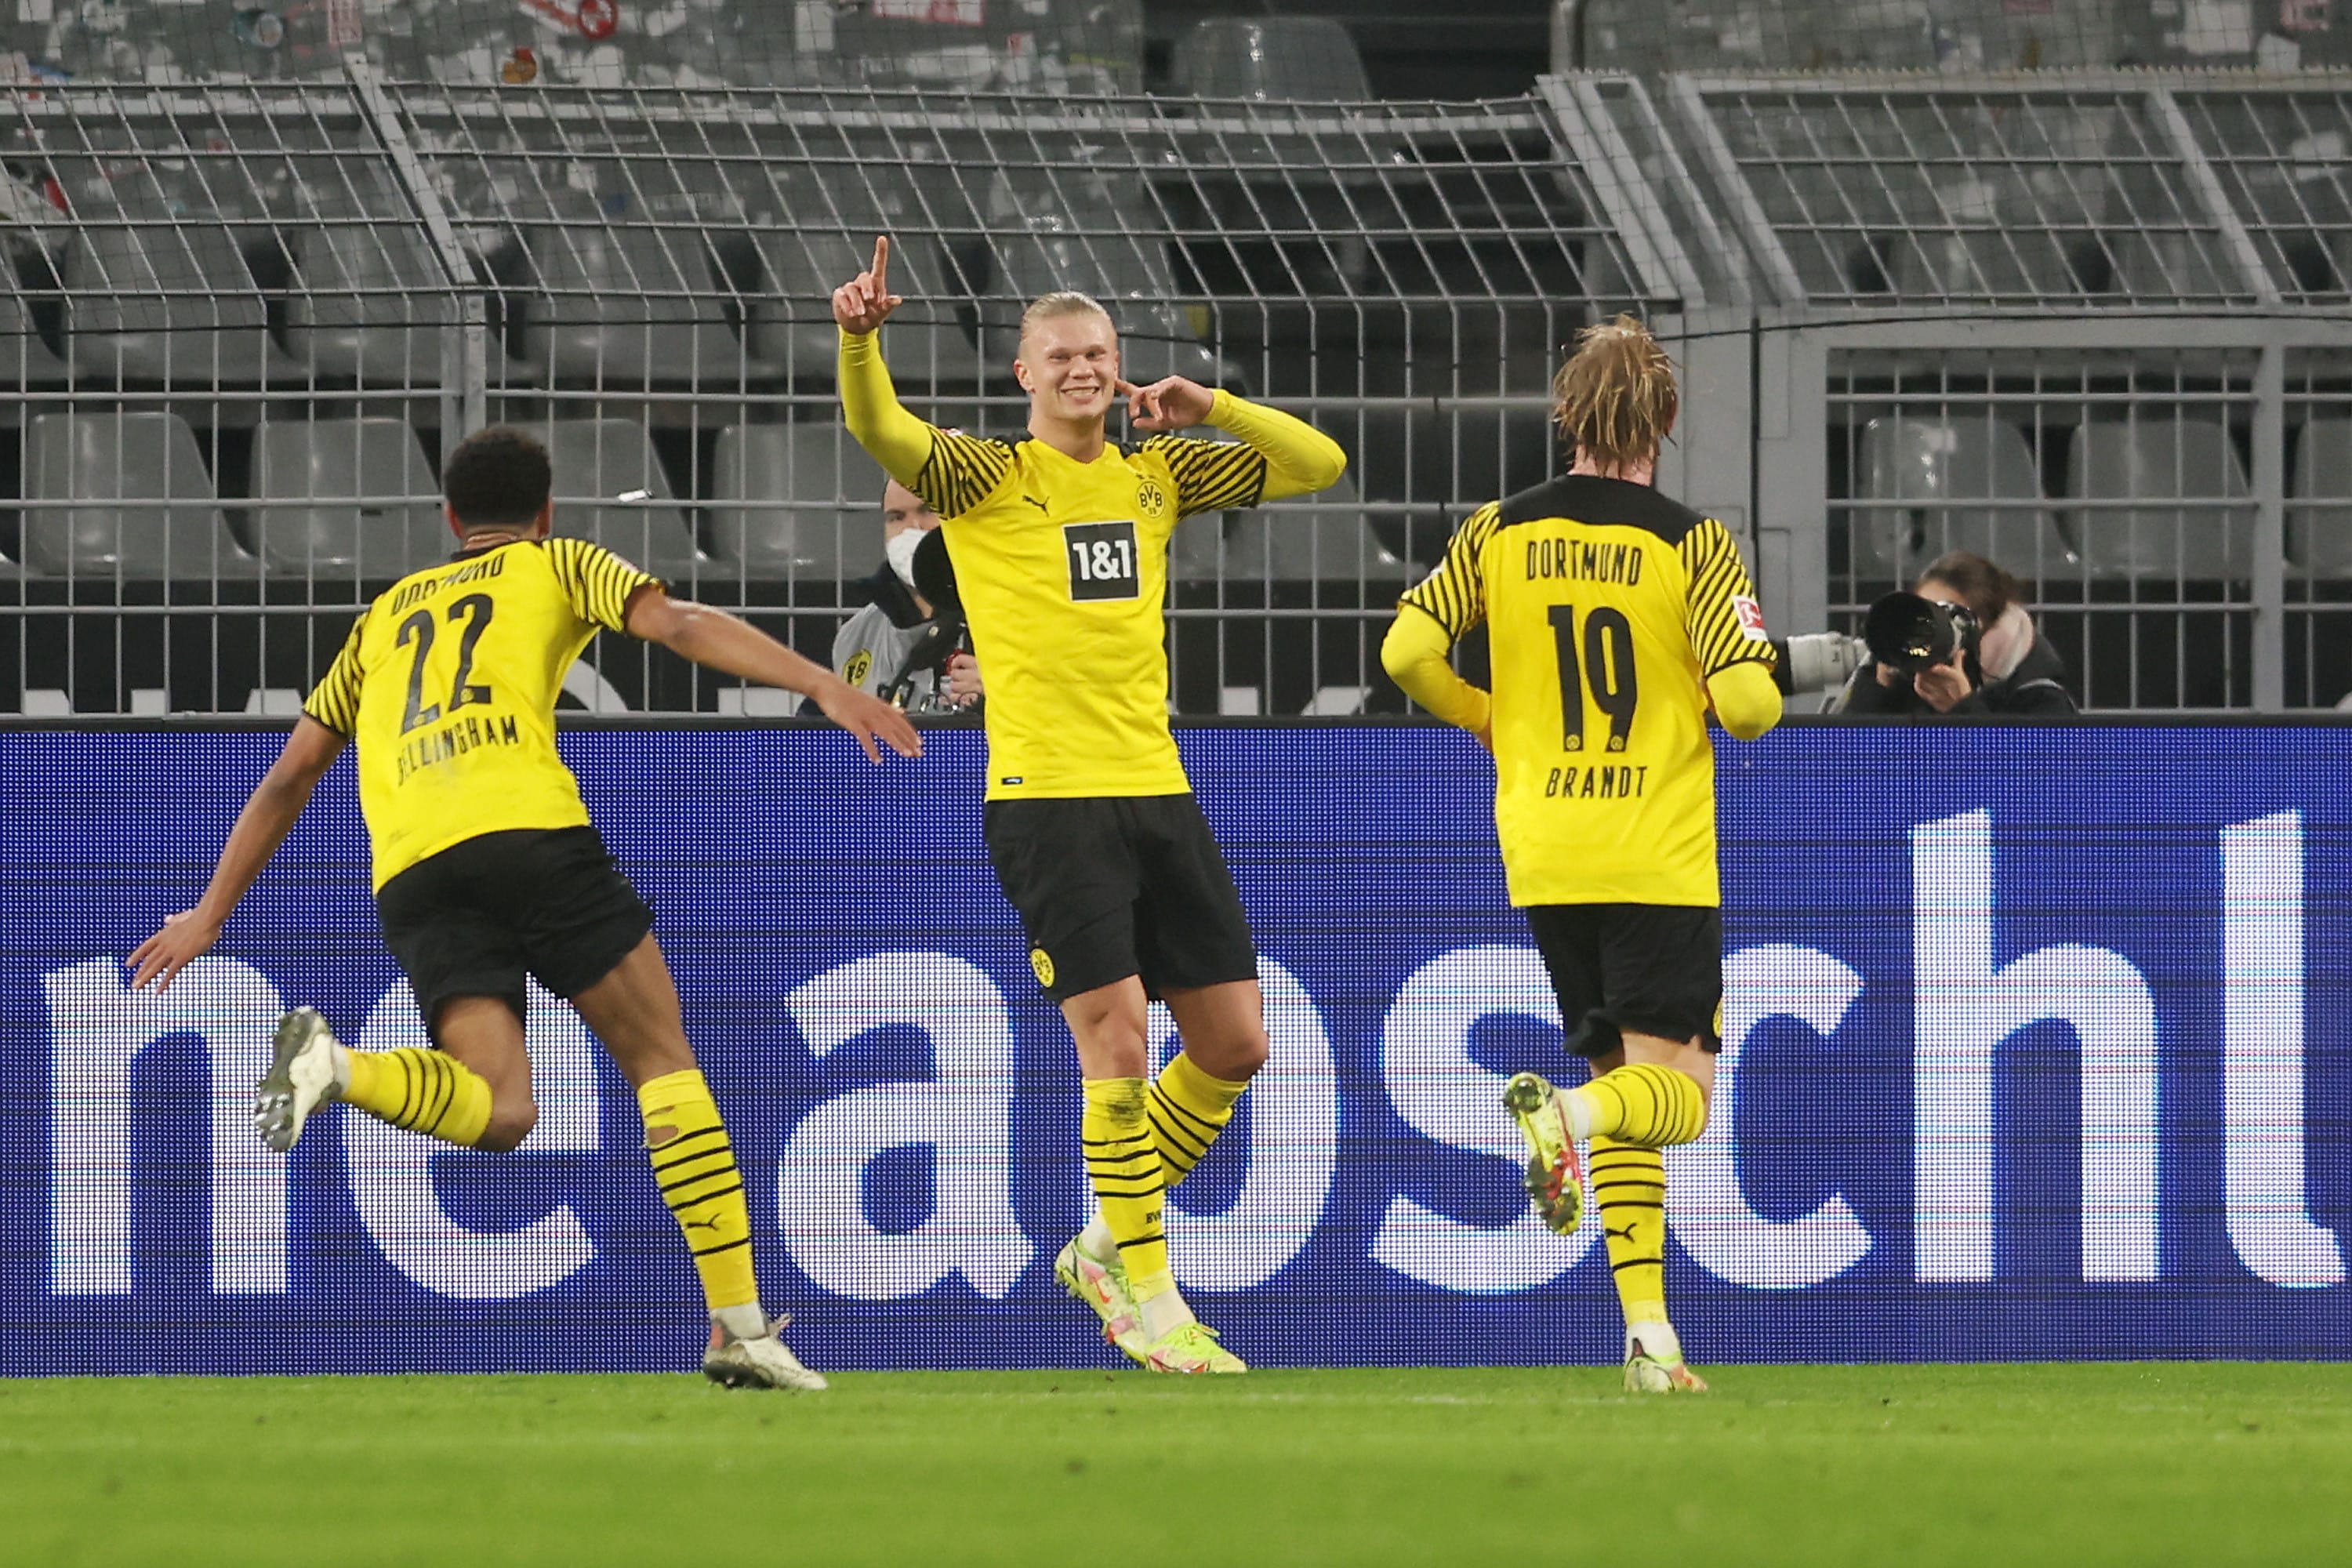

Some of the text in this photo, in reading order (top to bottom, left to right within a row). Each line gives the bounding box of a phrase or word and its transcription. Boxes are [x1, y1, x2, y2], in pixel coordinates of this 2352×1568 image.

[1139, 485, 1162, 507] BVB
[1073, 539, 1131, 580] 1&1
[1526, 539, 1642, 586] DORTMUND
[390, 552, 506, 616] DORTMUND
[395, 593, 493, 737] 22
[1548, 604, 1637, 752] 19
[1544, 766, 1647, 798] BRANDT
